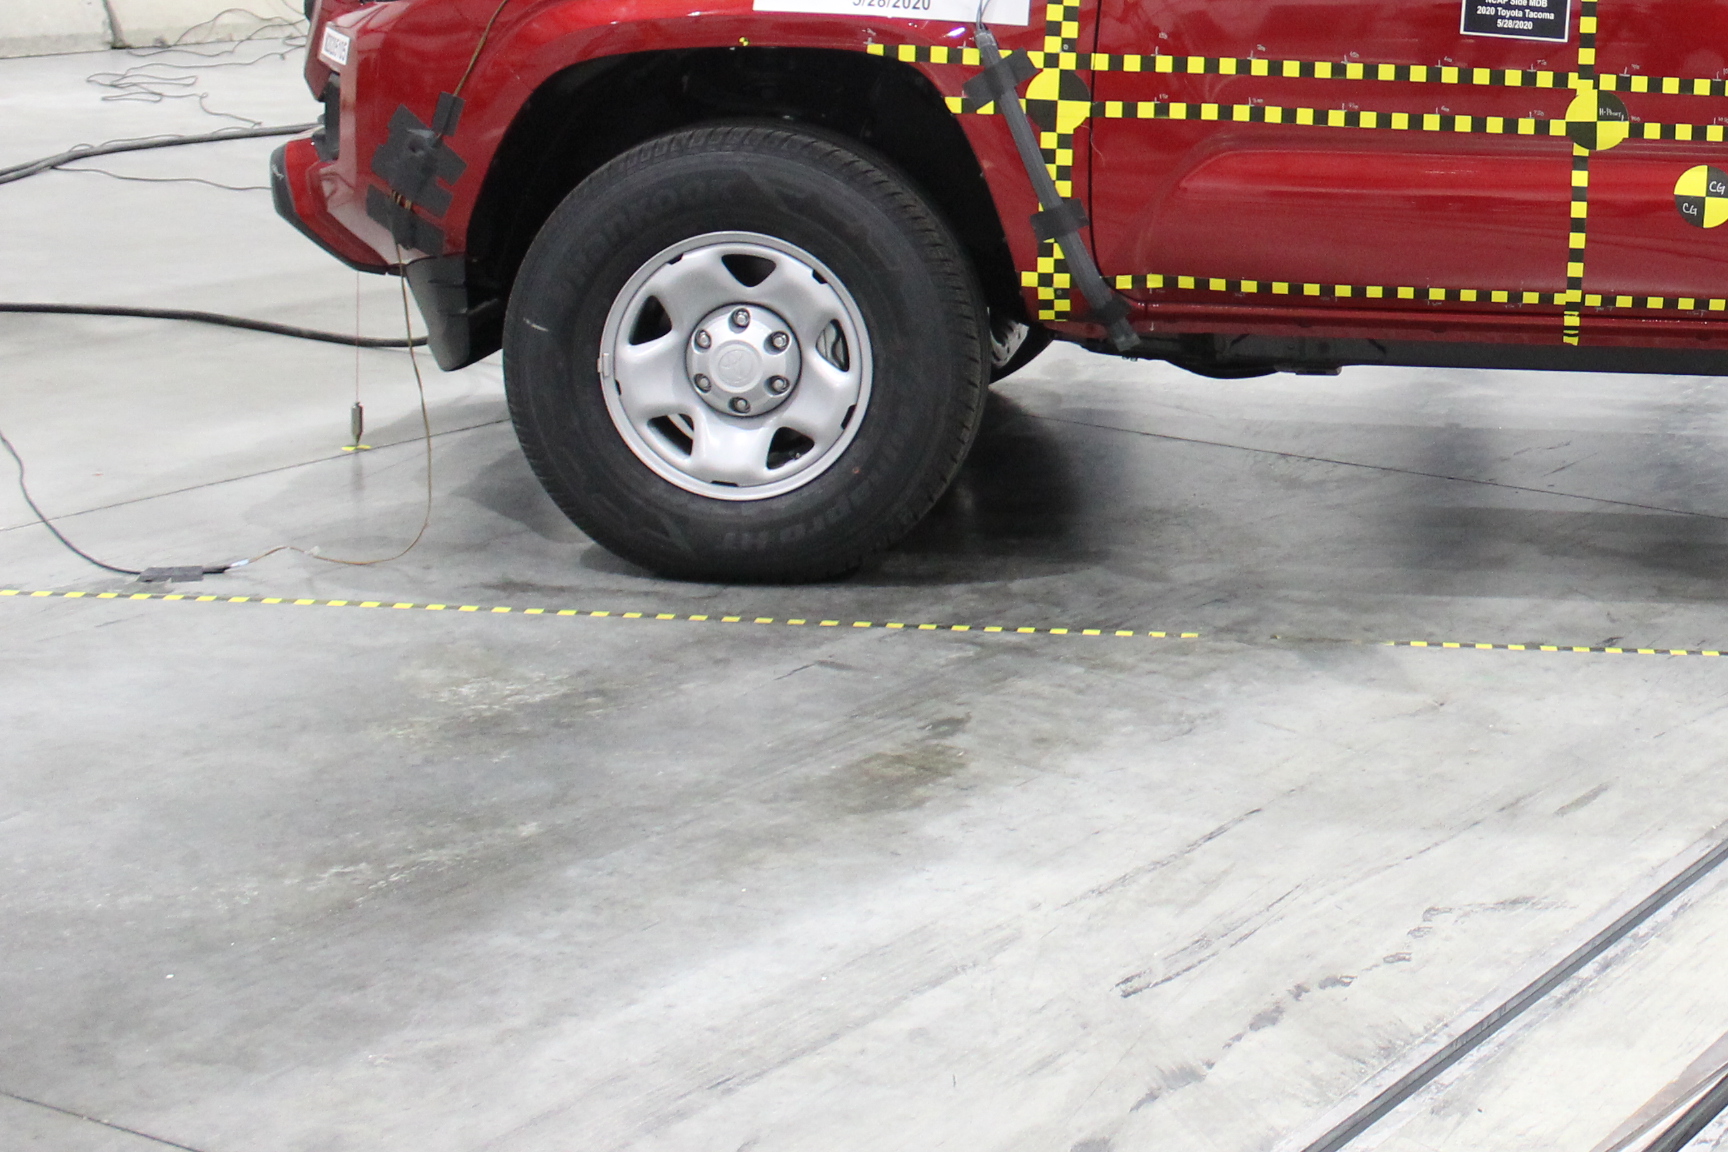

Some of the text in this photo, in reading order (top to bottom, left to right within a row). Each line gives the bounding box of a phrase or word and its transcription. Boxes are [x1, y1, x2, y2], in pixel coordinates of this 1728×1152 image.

[1476, 5, 1555, 20] 2020 Toyota Tacoma
[1496, 18, 1533, 30] 5/28/2020
[1709, 180, 1726, 195] CG
[1682, 202, 1698, 216] CG
